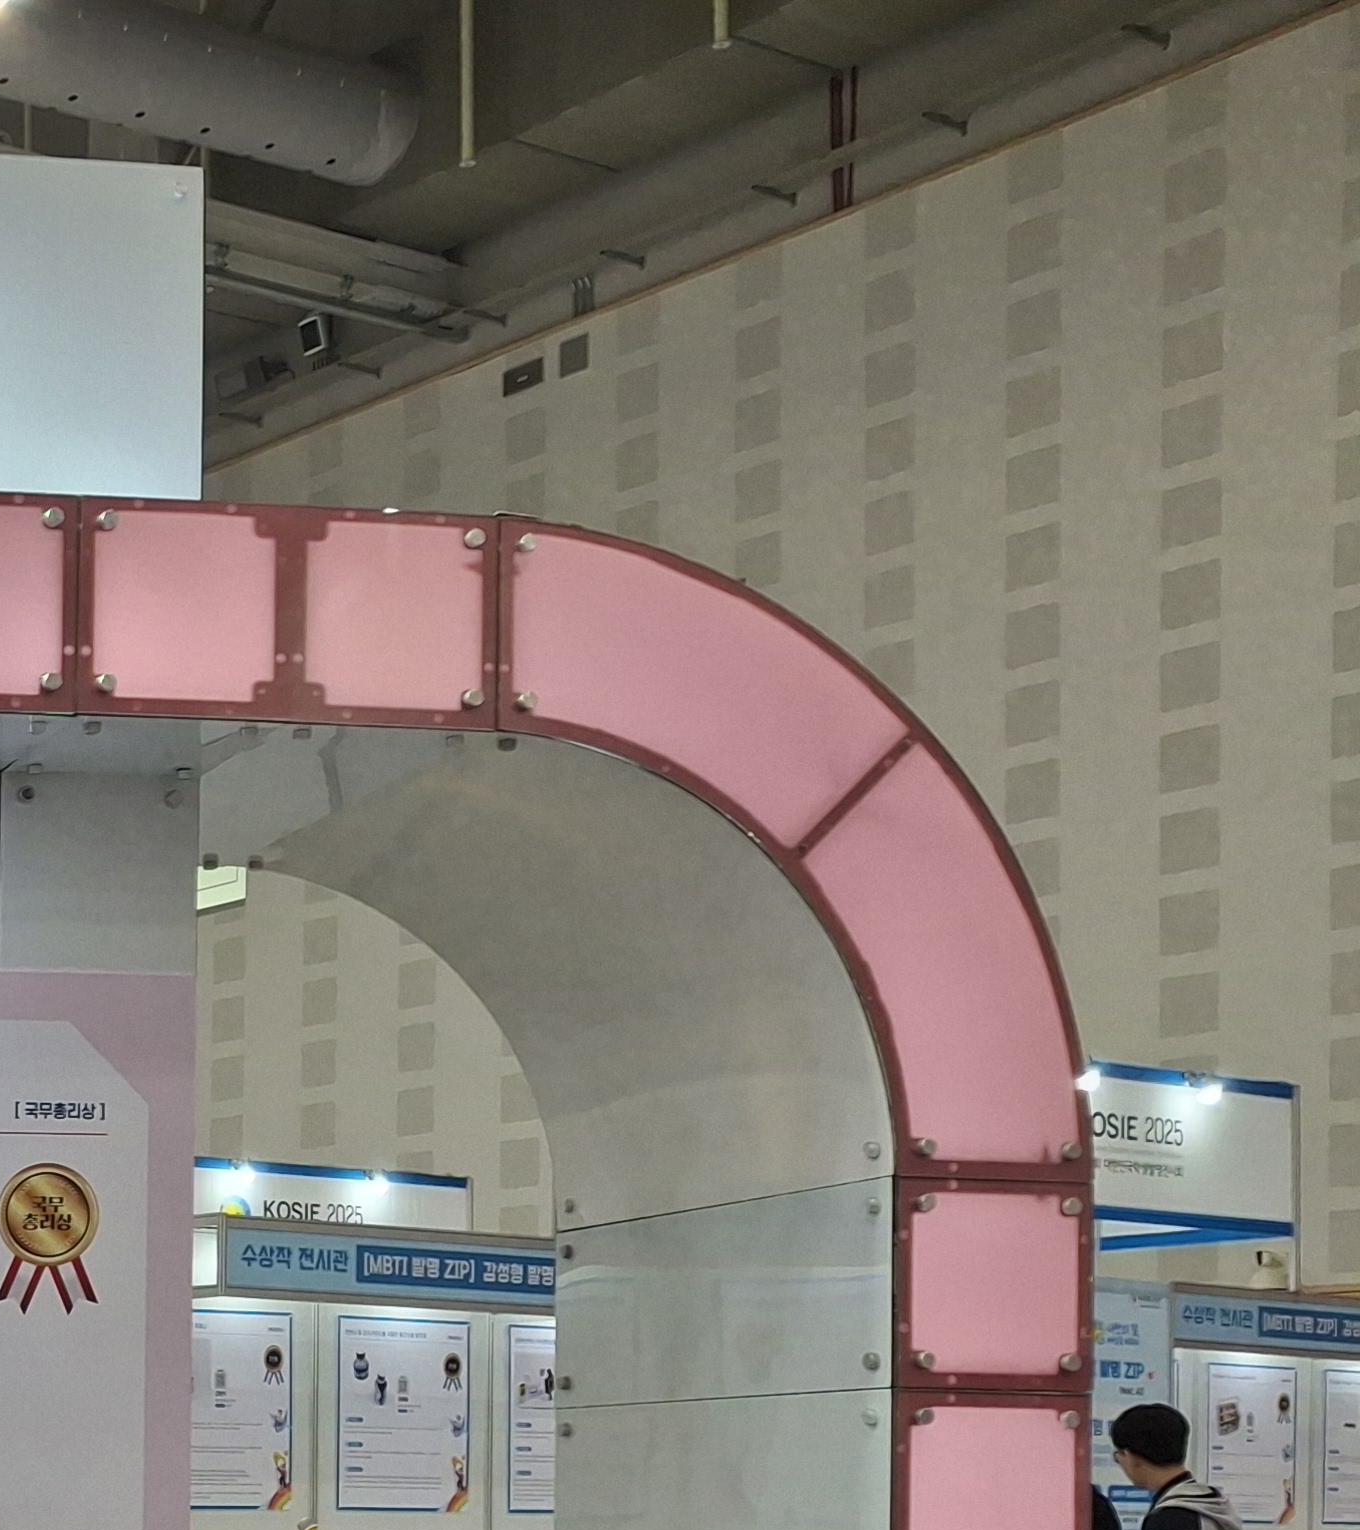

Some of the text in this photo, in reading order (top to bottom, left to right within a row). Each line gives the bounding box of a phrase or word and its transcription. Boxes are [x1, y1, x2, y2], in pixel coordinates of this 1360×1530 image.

[24, 1102, 97, 1120] 국무총리상
[1145, 1117, 1183, 1146] 2025
[32, 1196, 65, 1213] 국무
[263, 1200, 363, 1225] KOSIE 2025
[22, 1213, 73, 1231] 총리상
[241, 1244, 293, 1269] 수상작
[298, 1246, 349, 1272] 전시관
